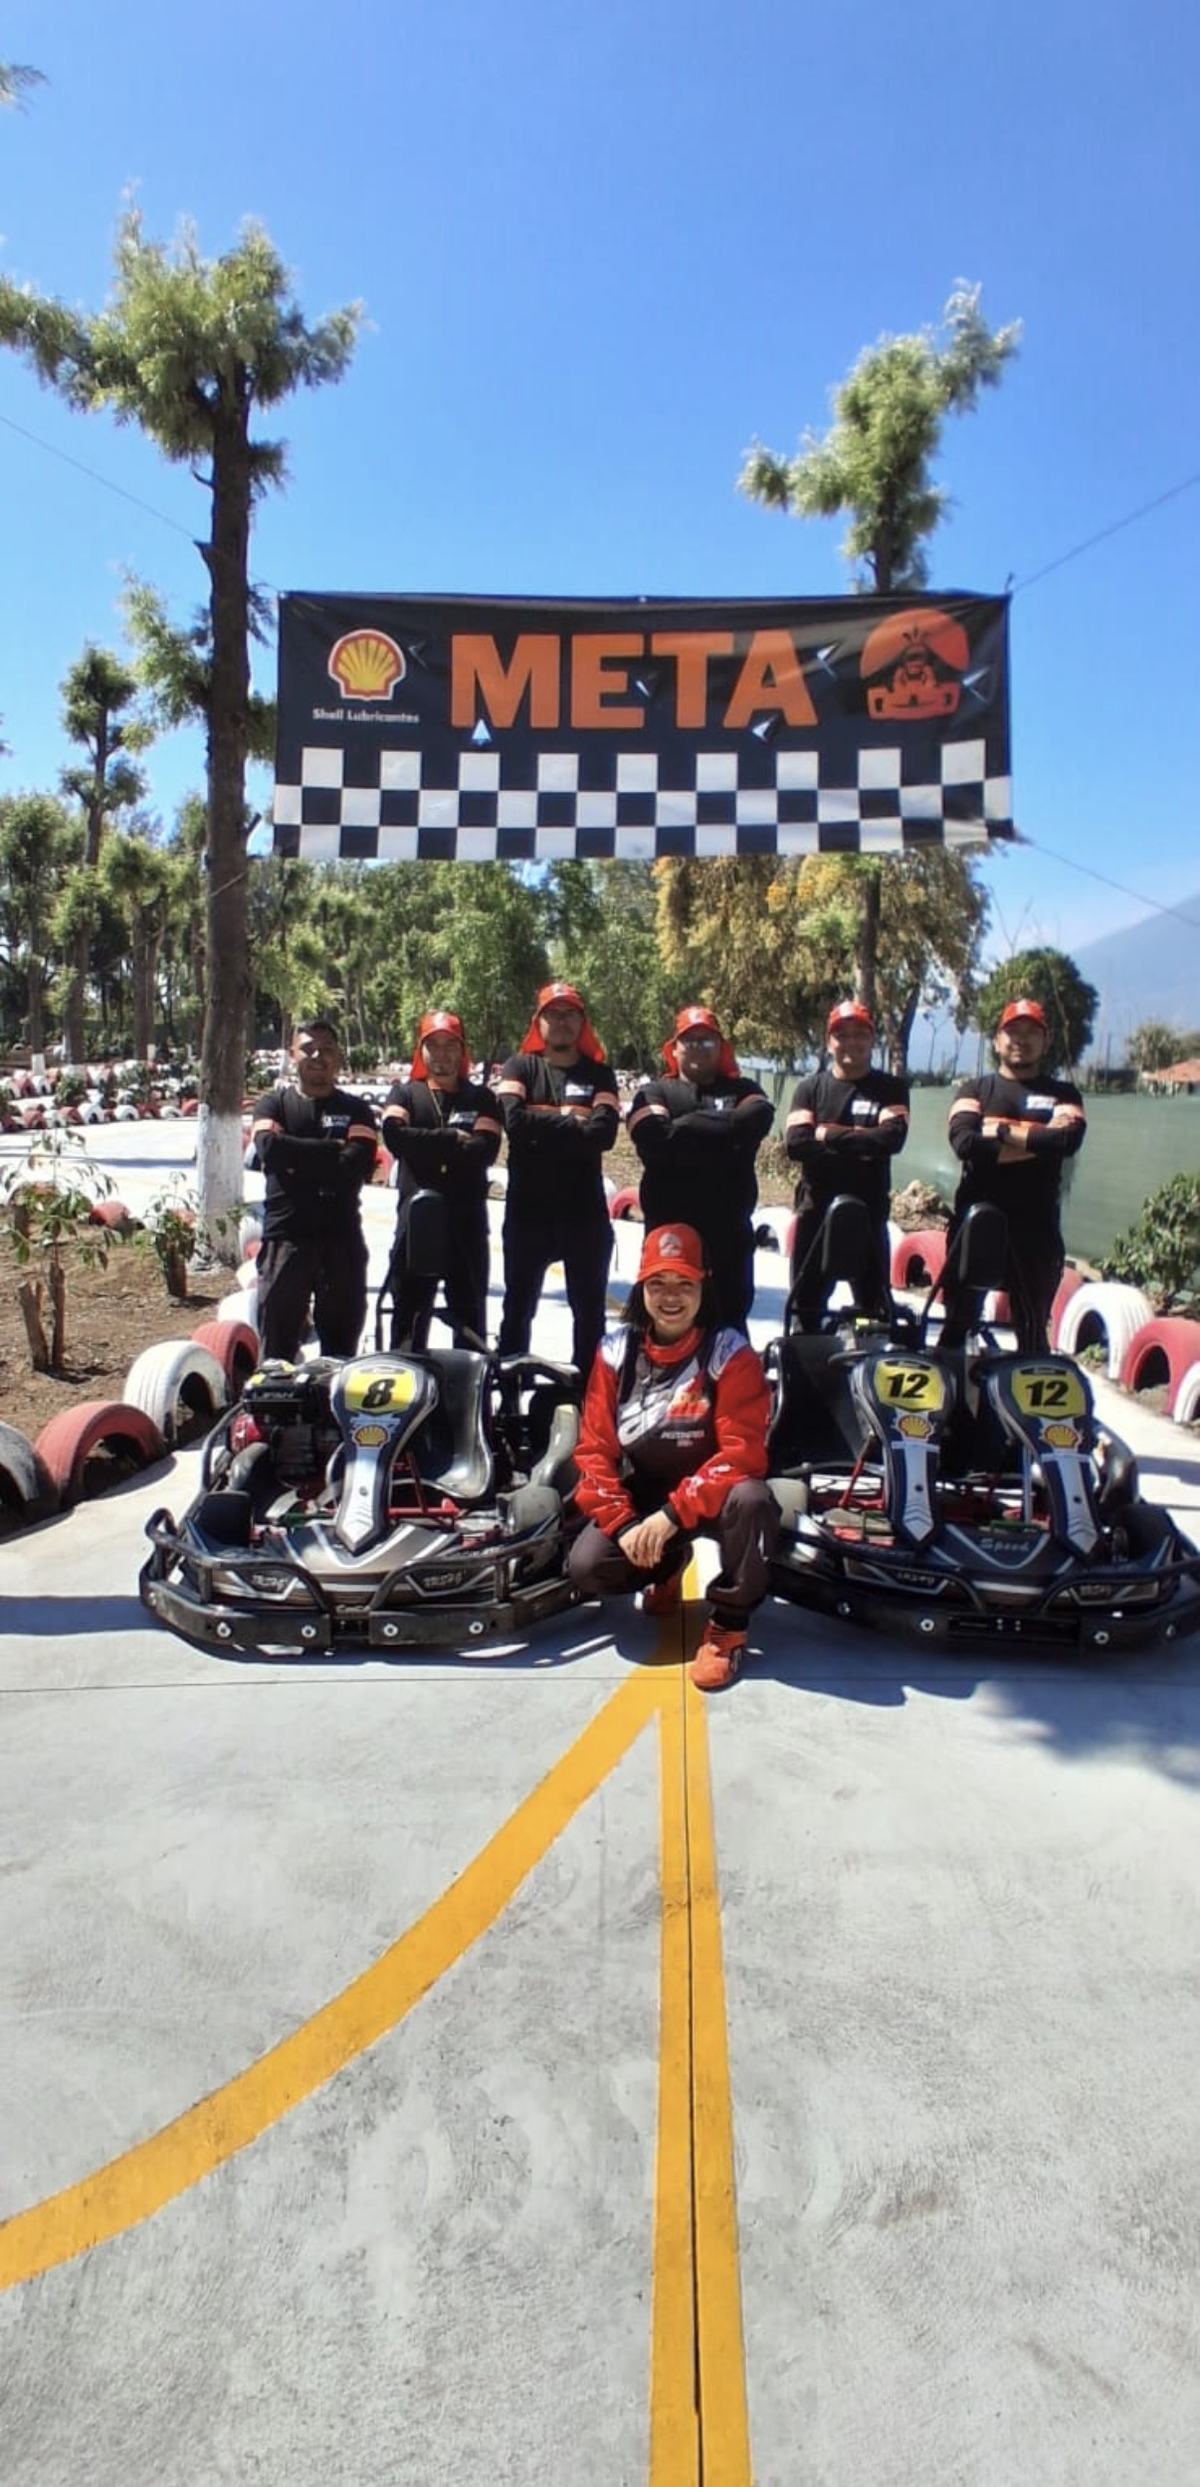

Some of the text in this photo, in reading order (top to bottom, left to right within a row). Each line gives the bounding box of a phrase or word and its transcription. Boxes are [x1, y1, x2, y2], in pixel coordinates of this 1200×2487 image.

[451, 631, 819, 729] META
[312, 708, 420, 723] Shell Lubricantes
[361, 1378, 397, 1408] 8
[887, 1373, 930, 1399] 12
[1026, 1380, 1070, 1407] 12
